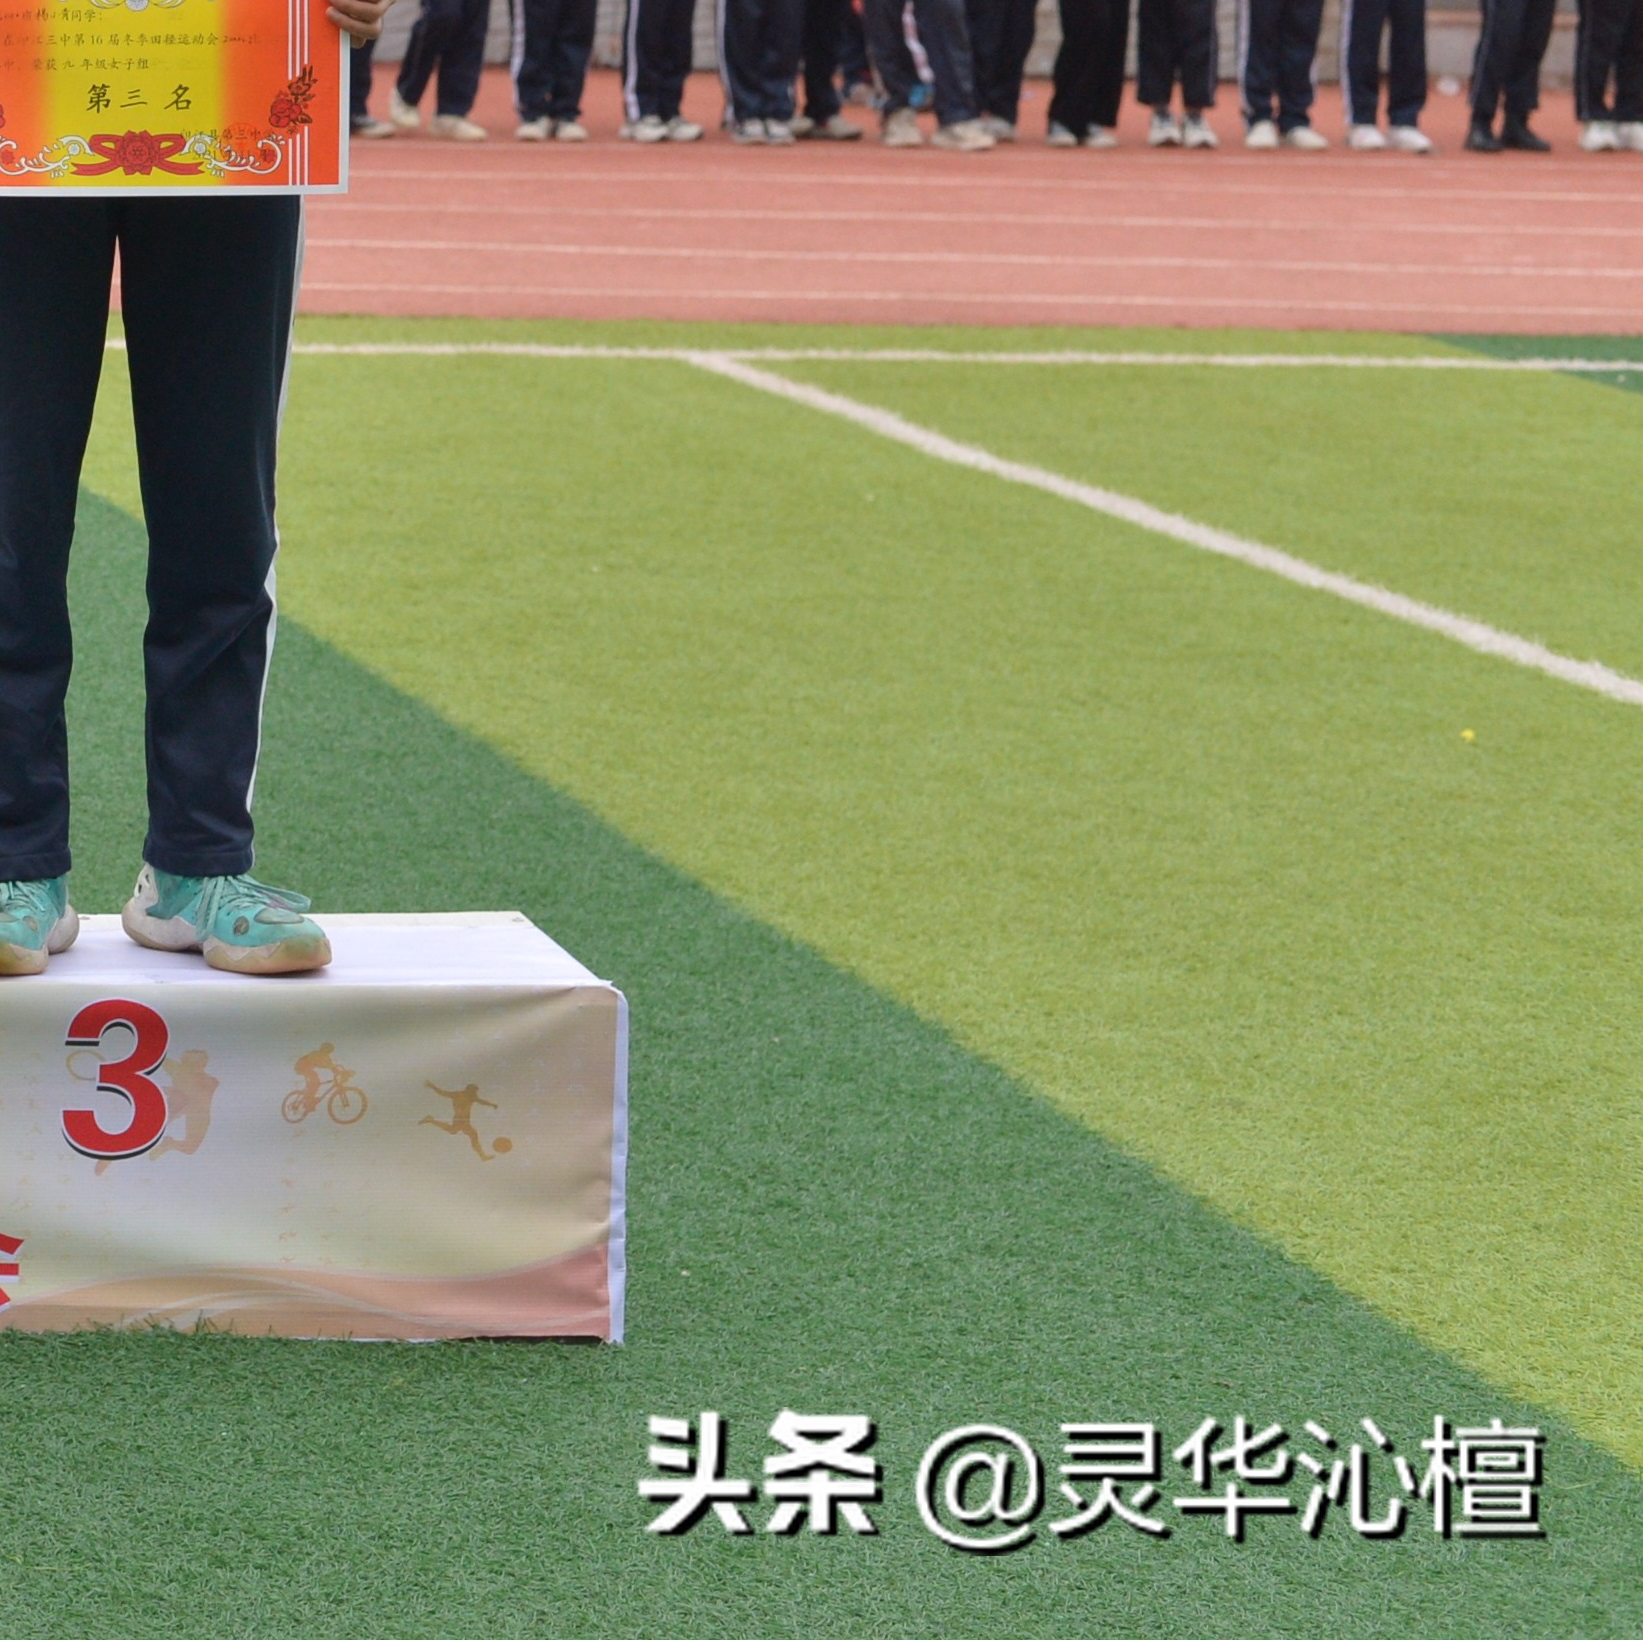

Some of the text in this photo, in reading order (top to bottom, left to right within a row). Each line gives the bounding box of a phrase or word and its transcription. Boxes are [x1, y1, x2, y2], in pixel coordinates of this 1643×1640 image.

[84, 83, 193, 114] 第三名
[60, 996, 169, 1162] 3
